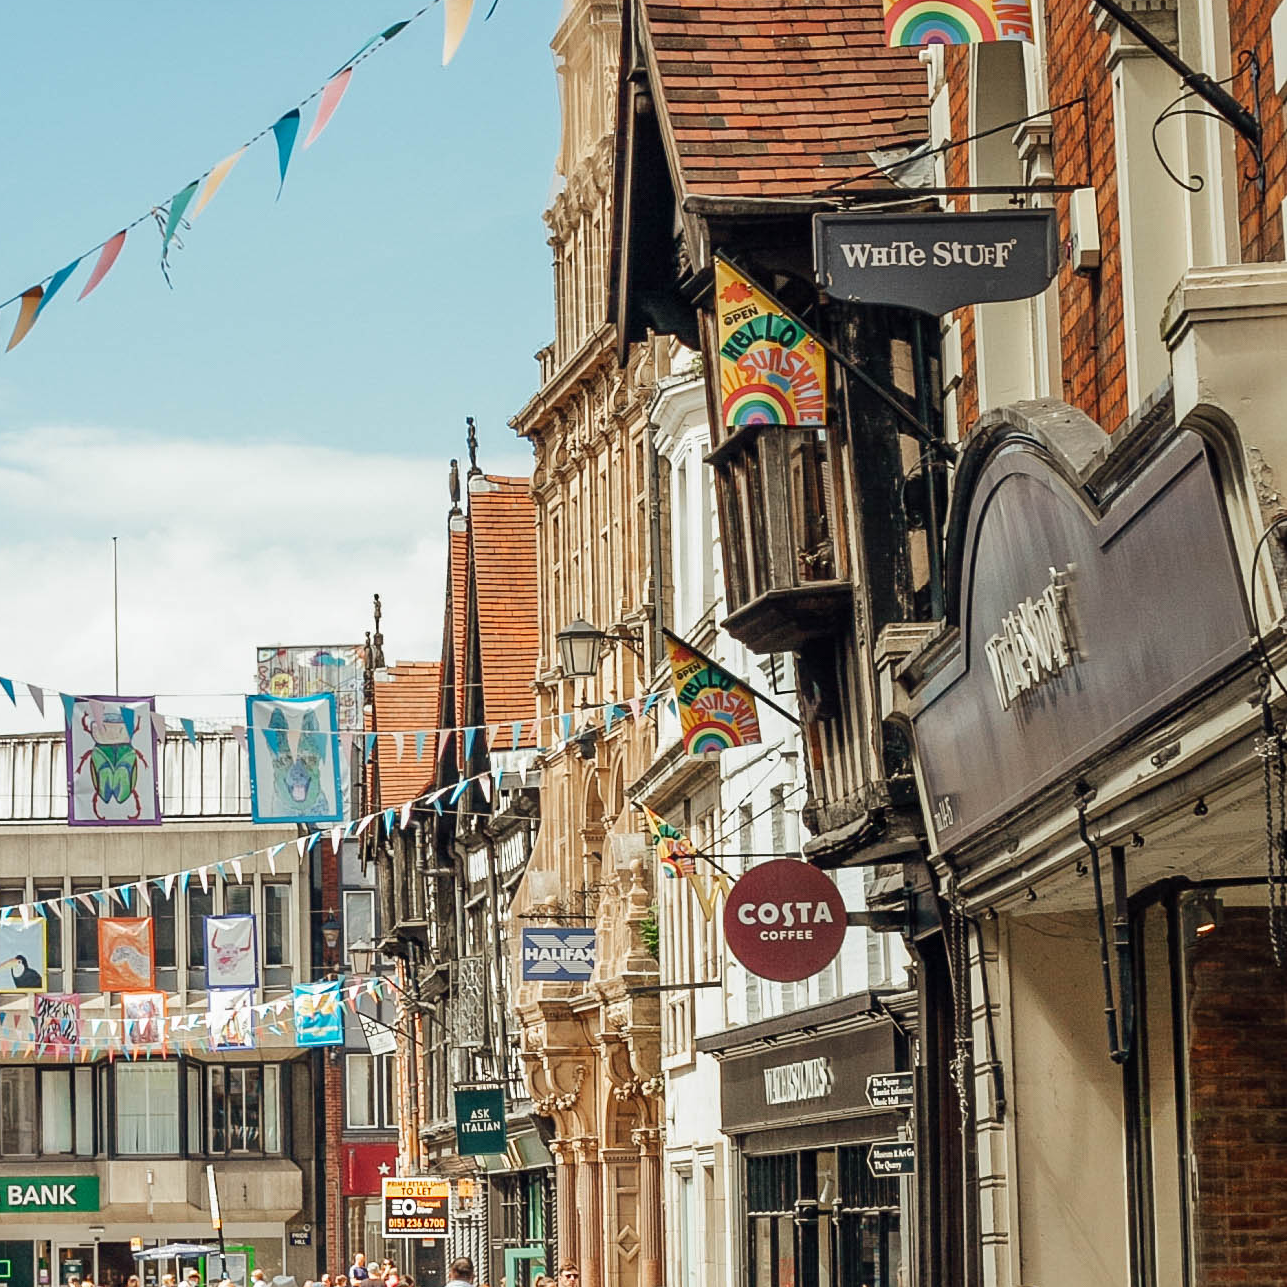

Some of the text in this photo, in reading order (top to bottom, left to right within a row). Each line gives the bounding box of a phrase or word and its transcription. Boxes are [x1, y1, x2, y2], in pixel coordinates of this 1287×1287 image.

[724, 307, 759, 326] OPEN
[676, 662, 703, 680] OPEN
[738, 901, 834, 927] COSTA
[760, 930, 814, 941] COFFEE
[524, 948, 597, 961] HALIFAX
[470, 1108, 490, 1119] ASK
[461, 1121, 501, 1133] ITALIAN
[7, 1185, 77, 1205] BANK
[401, 1187, 432, 1195] TO LET
[388, 1218, 445, 1228] 0151 236 6700
